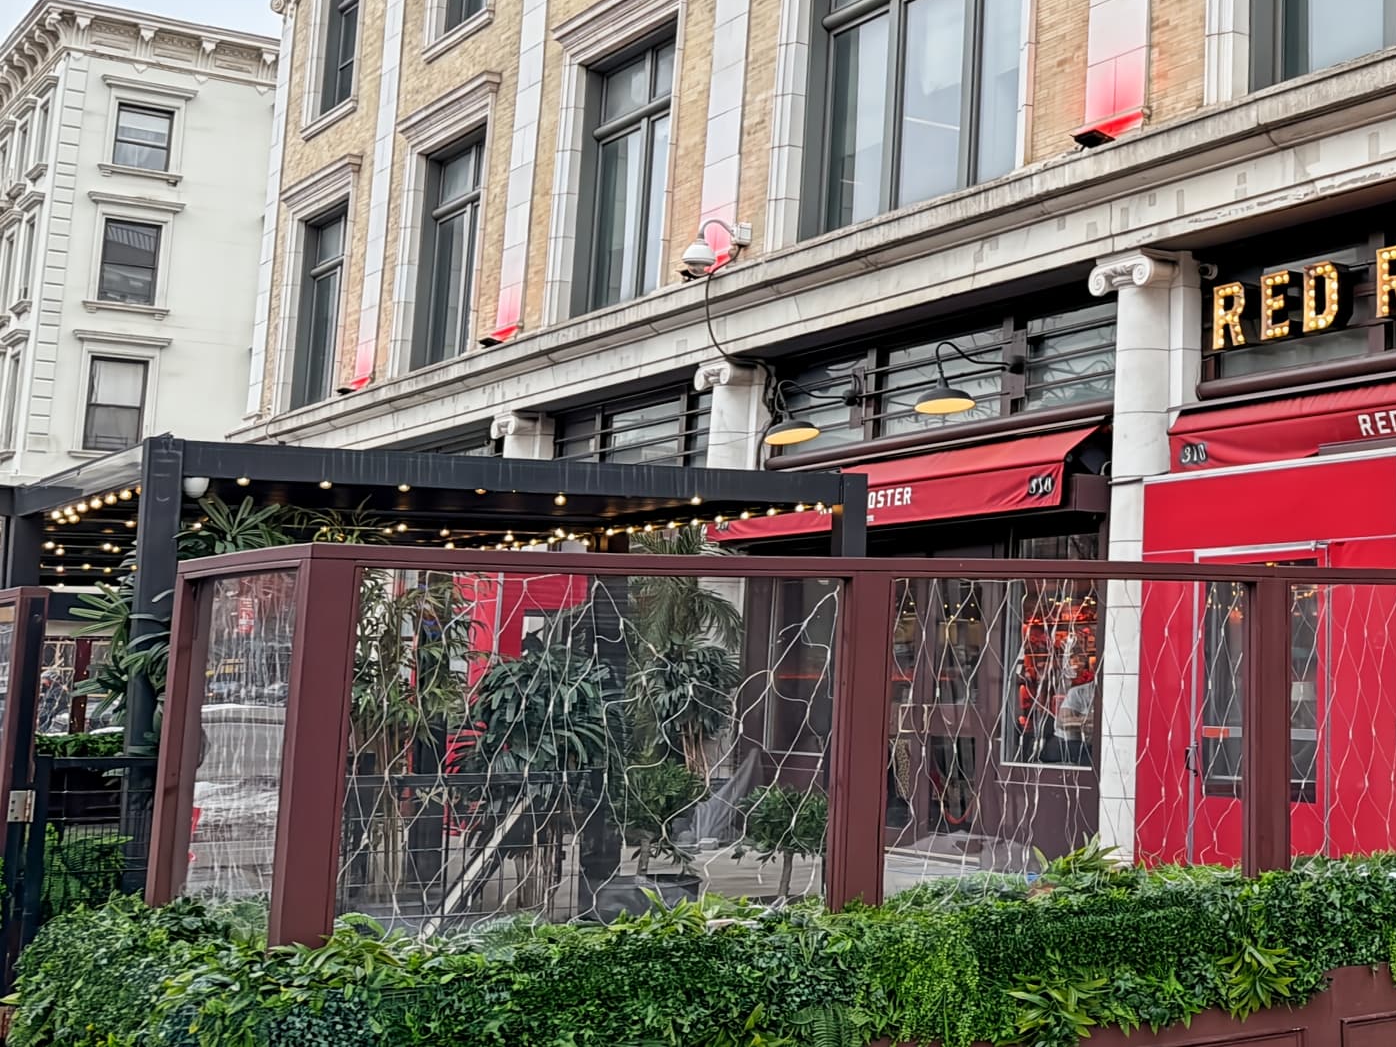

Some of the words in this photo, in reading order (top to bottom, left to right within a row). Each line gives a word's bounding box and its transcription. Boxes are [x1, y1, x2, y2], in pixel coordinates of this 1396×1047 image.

[1212, 260, 1339, 350] RED
[1181, 443, 1207, 463] 310
[867, 486, 913, 509] OSTER
